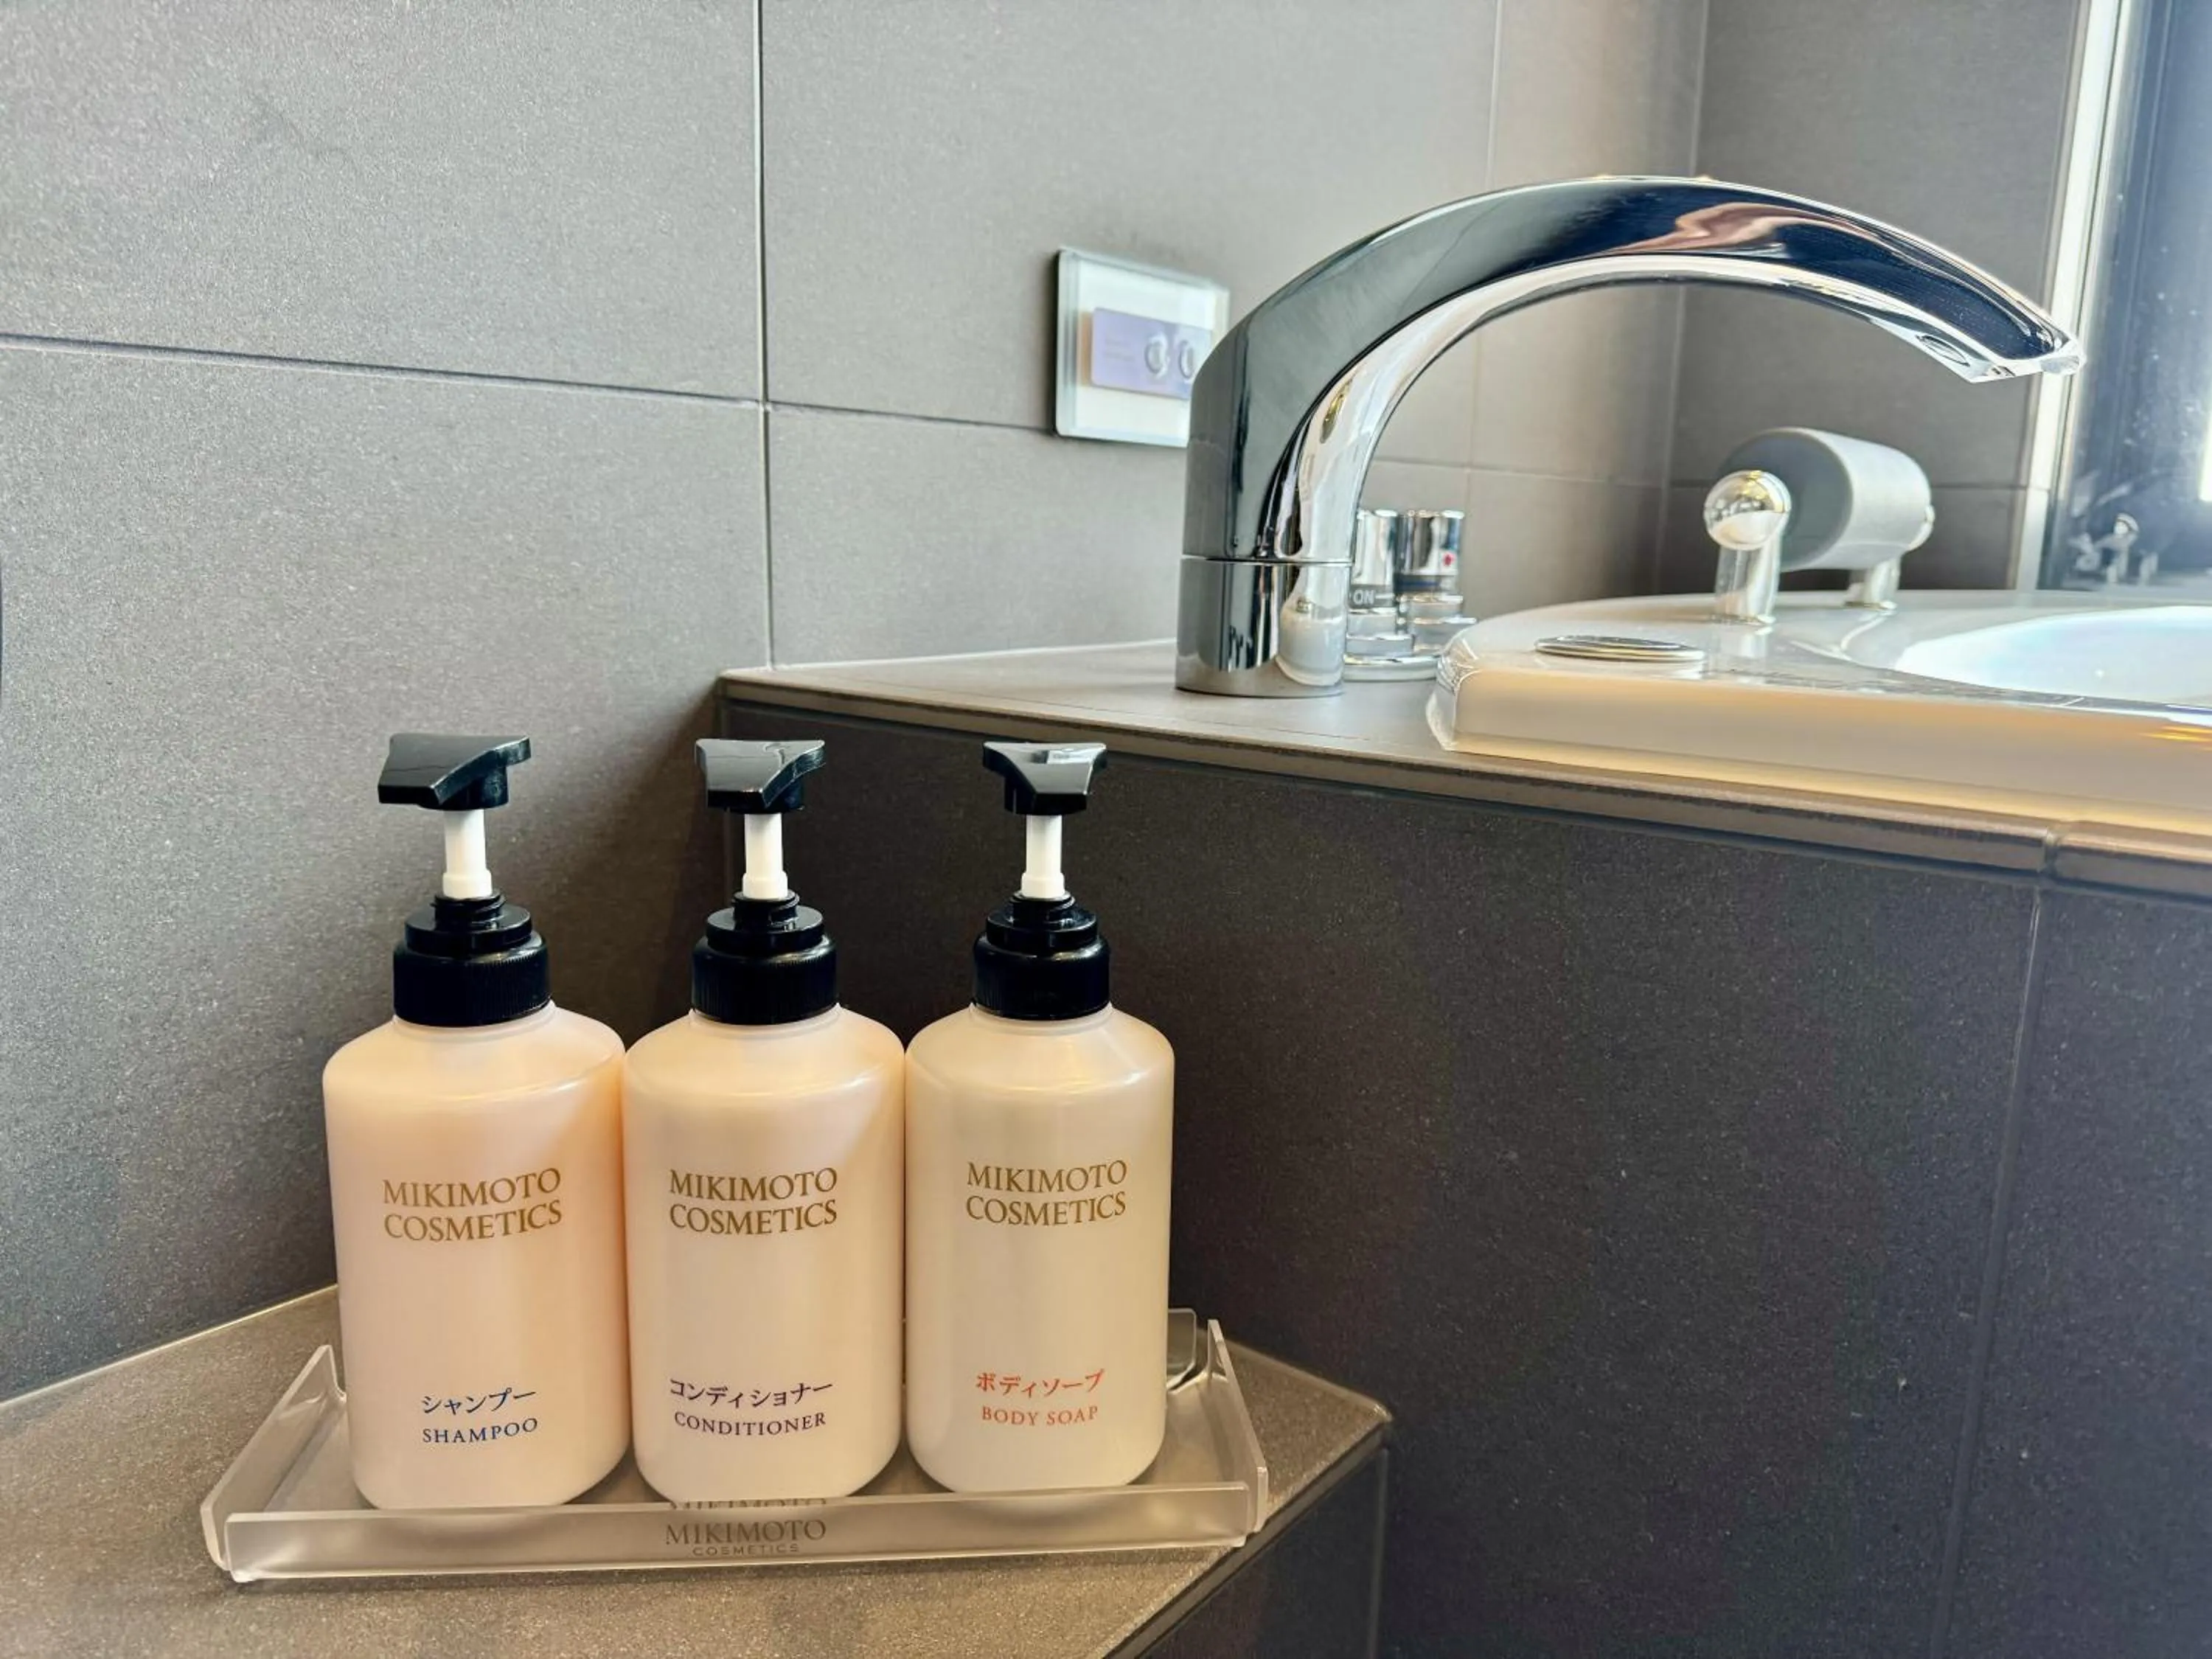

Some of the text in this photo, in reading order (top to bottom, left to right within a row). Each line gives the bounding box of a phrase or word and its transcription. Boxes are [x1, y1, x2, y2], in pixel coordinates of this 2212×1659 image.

[1353, 589, 1375, 605] ON
[383, 1168, 561, 1208] MIKIMOTO
[669, 1167, 838, 1202] MIKIMOTO
[967, 1160, 1127, 1194] MIKIMOTO
[384, 1199, 563, 1242] COSMETICS
[669, 1199, 838, 1236] COSMETICS
[966, 1191, 1127, 1225] COSMETICS
[669, 1378, 833, 1409] コンディショナー
[975, 1368, 1105, 1398] ボディソープ
[422, 1387, 537, 1416] シャンプー
[981, 1404, 1099, 1426] BODY SOAP
[422, 1418, 538, 1443] SHAMPOO
[674, 1411, 827, 1436] CONDITIONER
[665, 1519, 827, 1545] MIKIMOTO
[692, 1543, 800, 1557] COSMETICS
